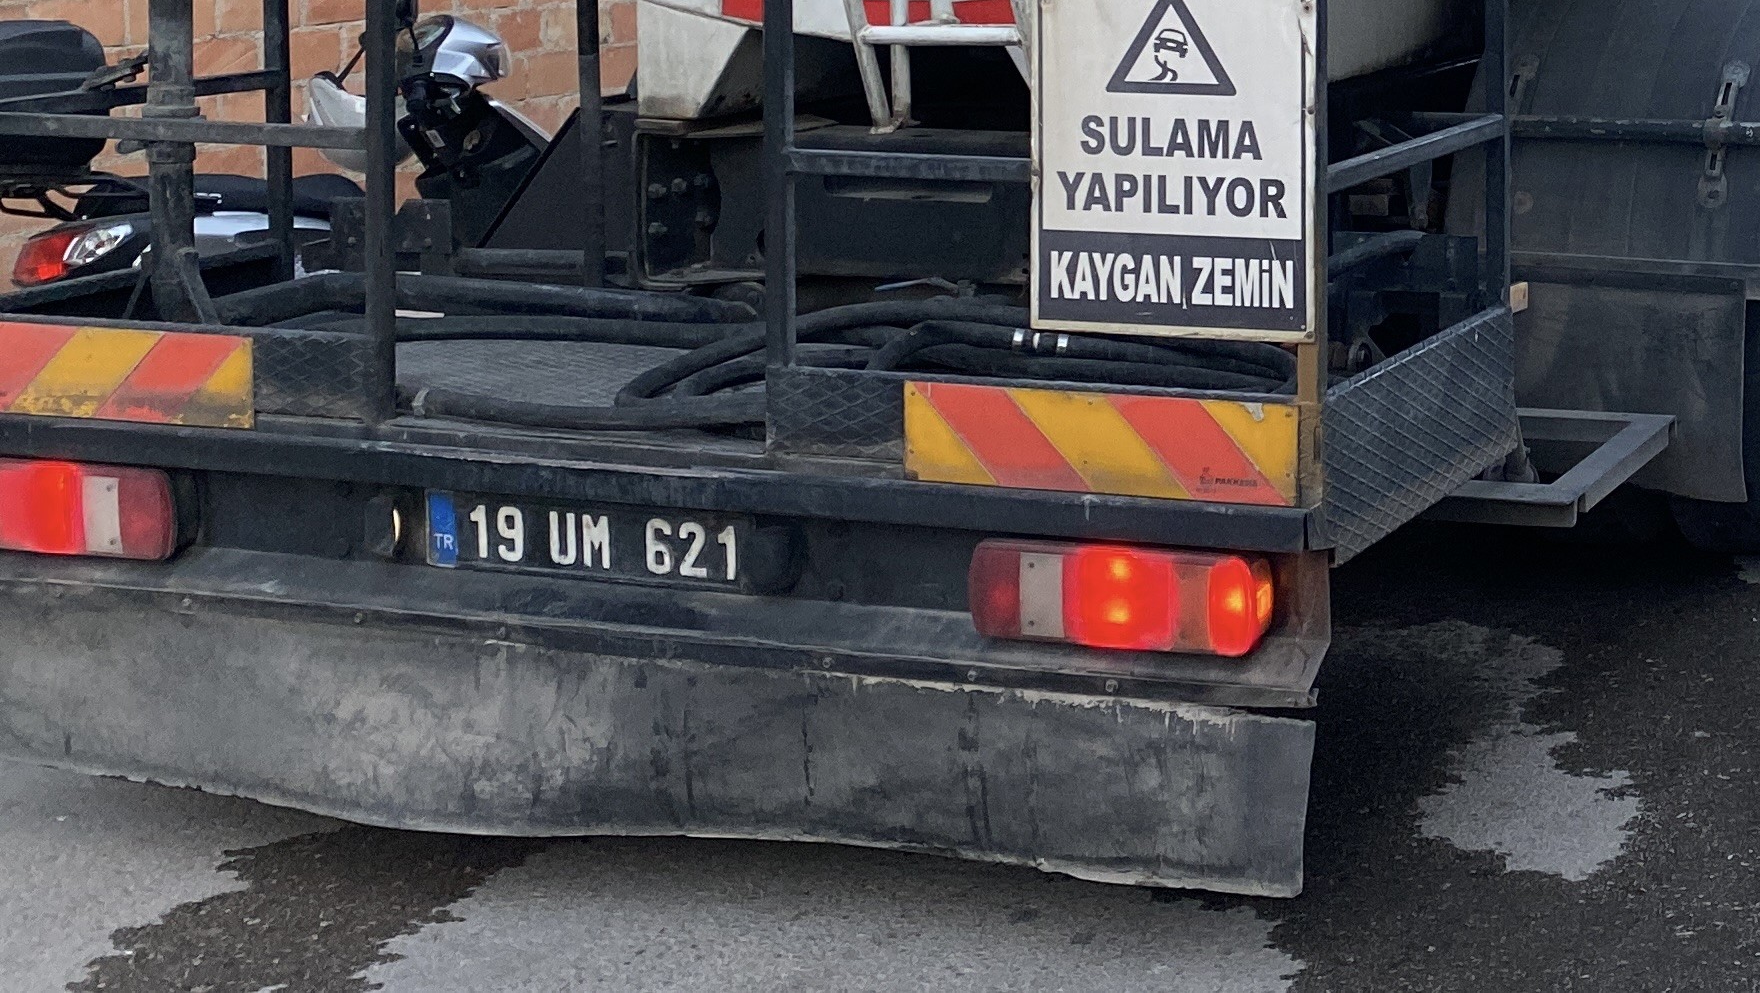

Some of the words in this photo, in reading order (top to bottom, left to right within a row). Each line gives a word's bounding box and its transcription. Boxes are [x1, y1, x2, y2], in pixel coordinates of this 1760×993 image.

[1080, 115, 1263, 160] SULAMA
[1056, 171, 1287, 219] YAPILIYOR
[1050, 250, 1182, 304] KAYGAN
[433, 533, 455, 549] TR
[469, 504, 524, 562] 19
[549, 510, 611, 569] UM
[645, 517, 737, 581] 621
